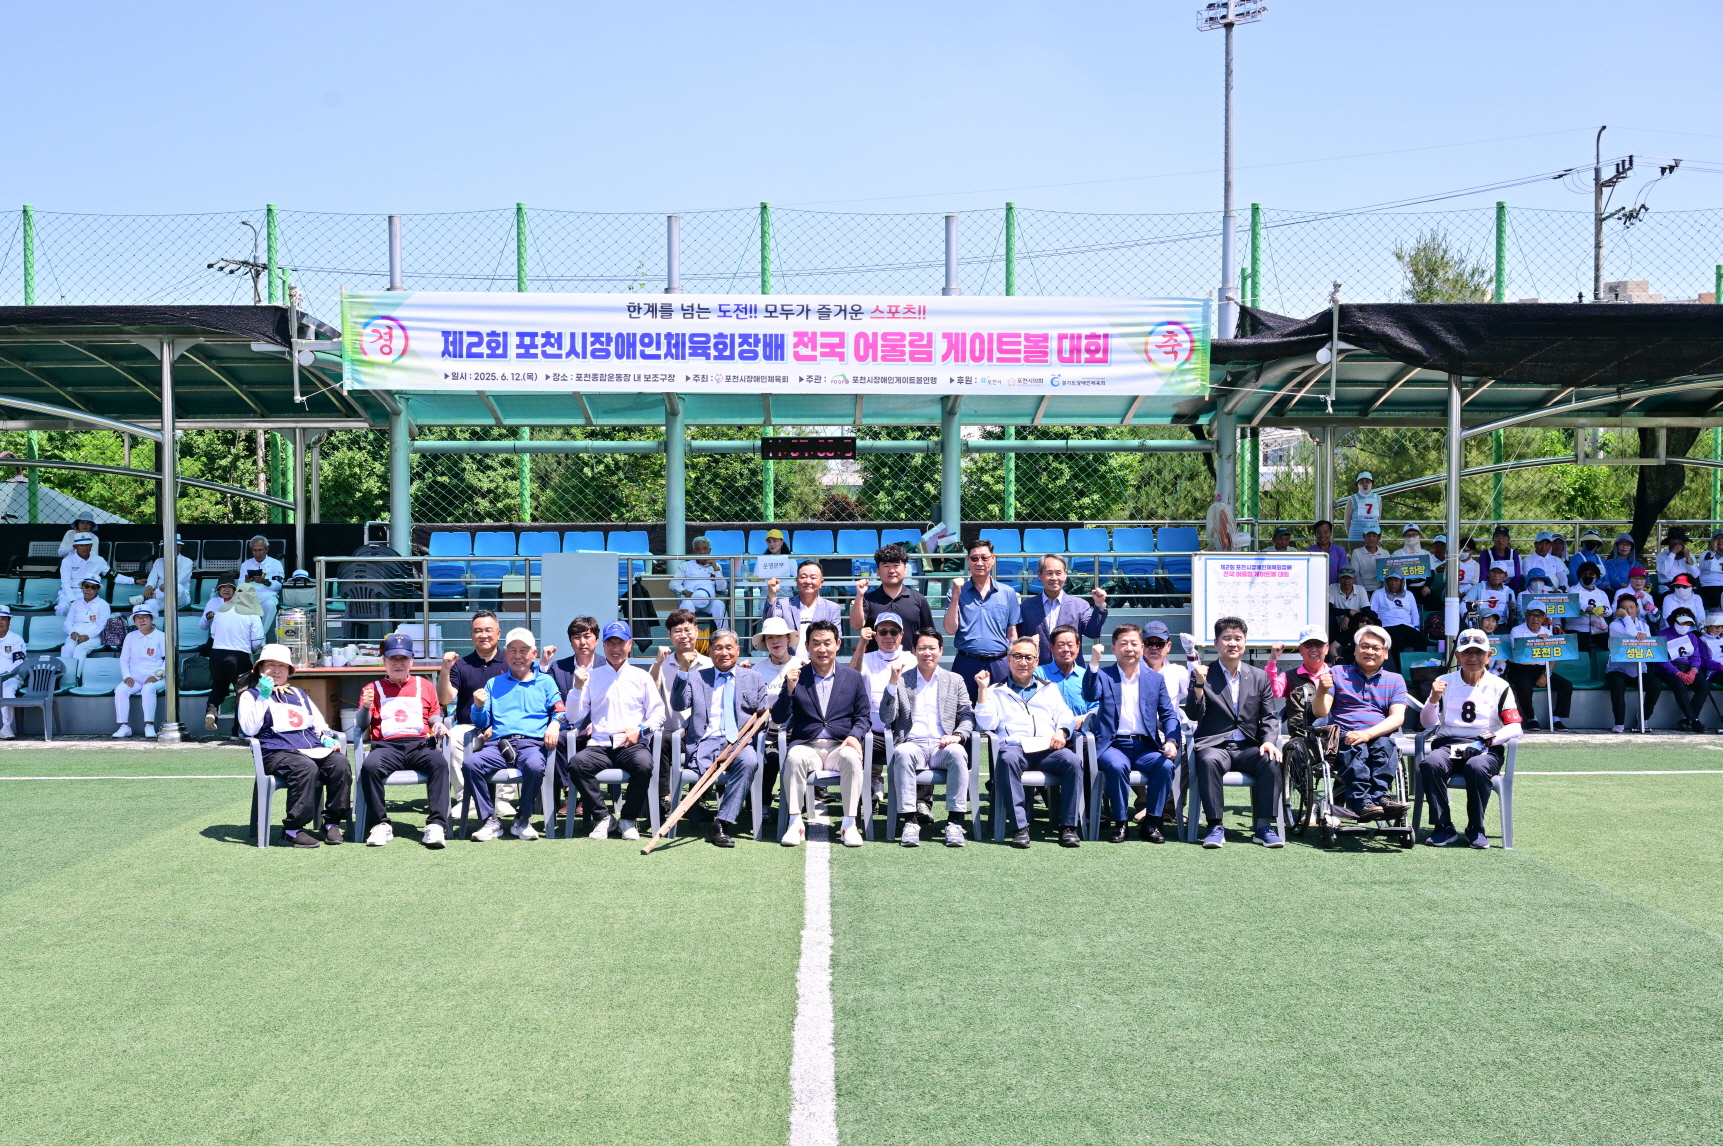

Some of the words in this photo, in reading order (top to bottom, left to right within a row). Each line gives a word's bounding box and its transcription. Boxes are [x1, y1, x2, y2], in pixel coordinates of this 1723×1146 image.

[626, 302, 674, 319] 한계를
[681, 303, 712, 319] 넘는
[717, 304, 758, 320] 도전!!
[763, 304, 811, 320] 모두가
[816, 304, 864, 320] 즐거운
[870, 304, 926, 320] 스포츠!!
[370, 325, 393, 356] 경
[1155, 330, 1182, 361] 축
[441, 330, 508, 359] 제2회
[515, 331, 785, 362] 포천시장애인체육회장배
[793, 331, 845, 362] 전국
[854, 331, 933, 363] 어울림
[941, 332, 1049, 364] 게이트볼
[1057, 332, 1110, 364] 대회
[451, 372, 467, 381] 일시
[474, 373, 498, 381] 2025.
[501, 373, 509, 381] 6.
[511, 373, 538, 382] 12.(목)
[552, 373, 569, 382] 장소
[575, 373, 631, 382] 포천종합운동장
[633, 373, 642, 382] 내
[643, 374, 676, 382] 보조구장
[692, 374, 709, 383] 주최
[724, 375, 789, 383] 포천시장애인체육회
[806, 375, 822, 383] 주관
[957, 376, 973, 385] 후원
[1365, 503, 1373, 515] 7
[1557, 604, 1566, 614] B
[1531, 647, 1552, 659] 포천
[1553, 646, 1563, 657] B
[1626, 647, 1645, 659] 성남
[1645, 648, 1655, 659] A
[1461, 700, 1477, 723] 8
[287, 709, 304, 728] 5
